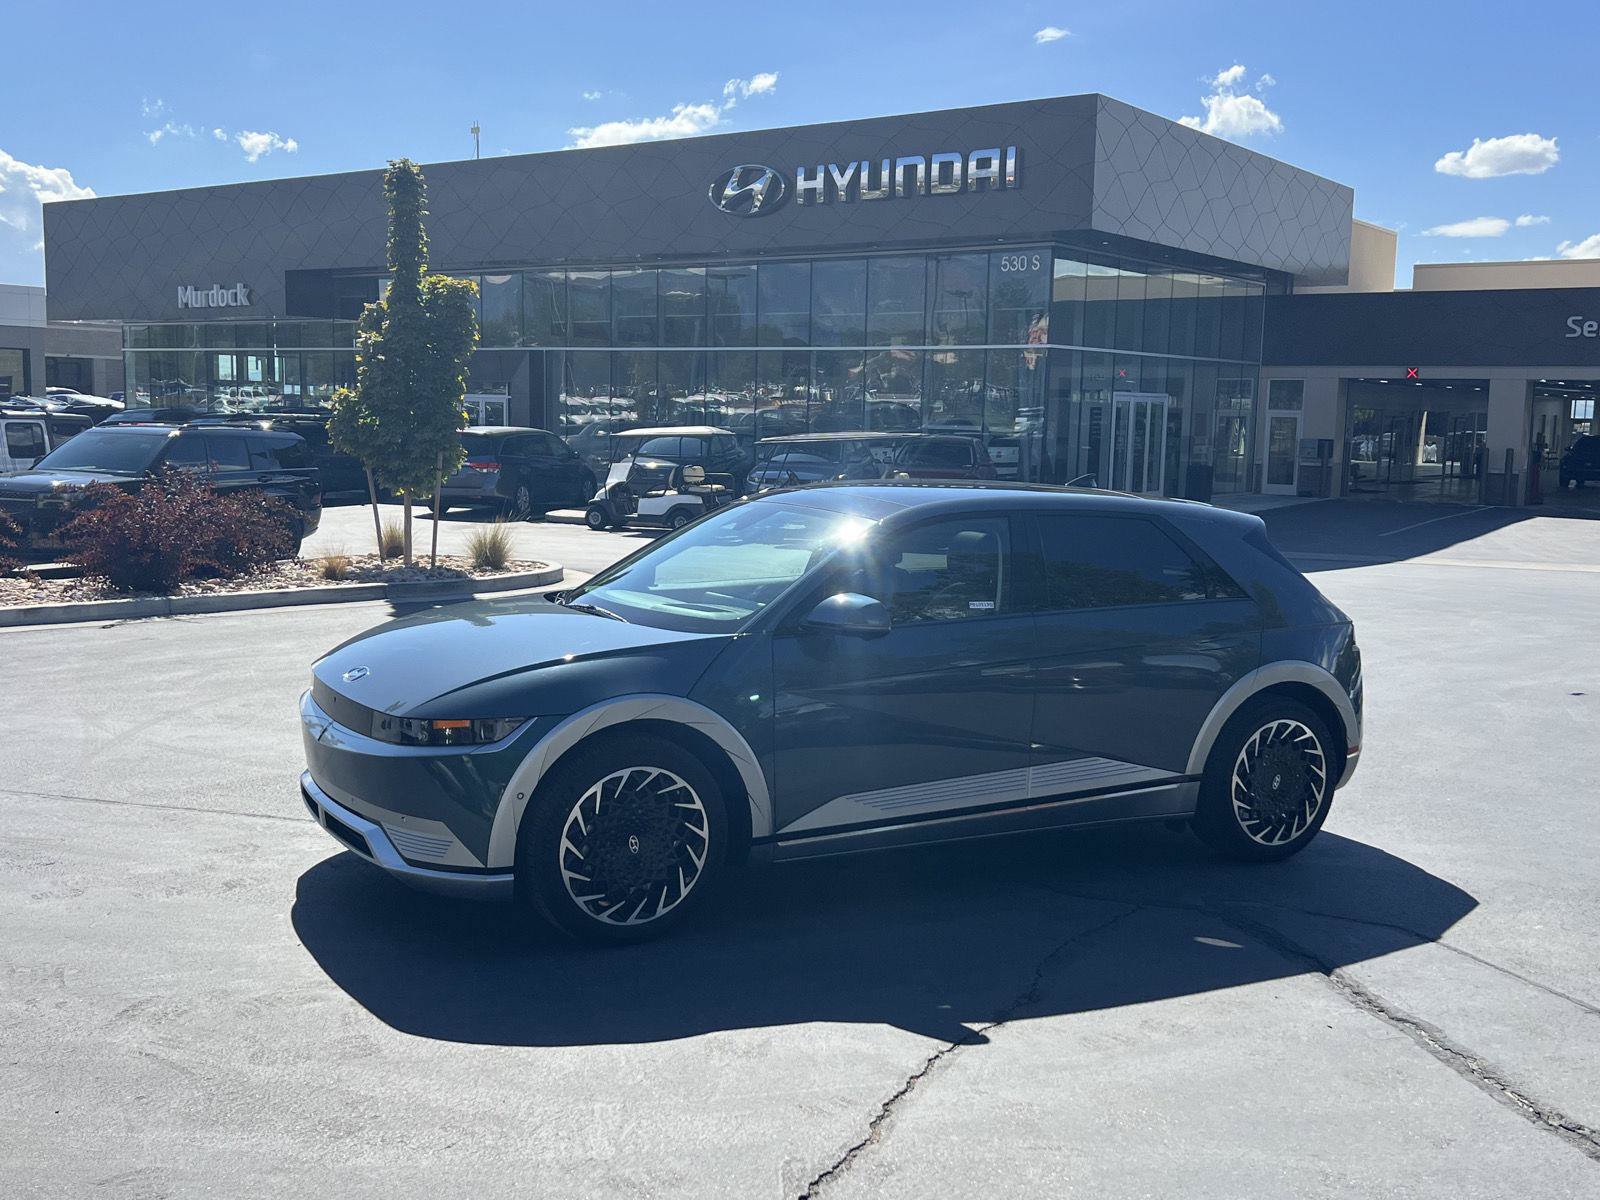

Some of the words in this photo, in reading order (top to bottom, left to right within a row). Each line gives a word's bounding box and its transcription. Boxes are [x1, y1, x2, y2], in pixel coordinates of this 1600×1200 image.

[796, 146, 1017, 205] HYUNDAI
[1001, 255, 1027, 271] 530
[1031, 254, 1040, 270] S
[177, 283, 250, 309] Murdock
[1565, 315, 1600, 338] Se
